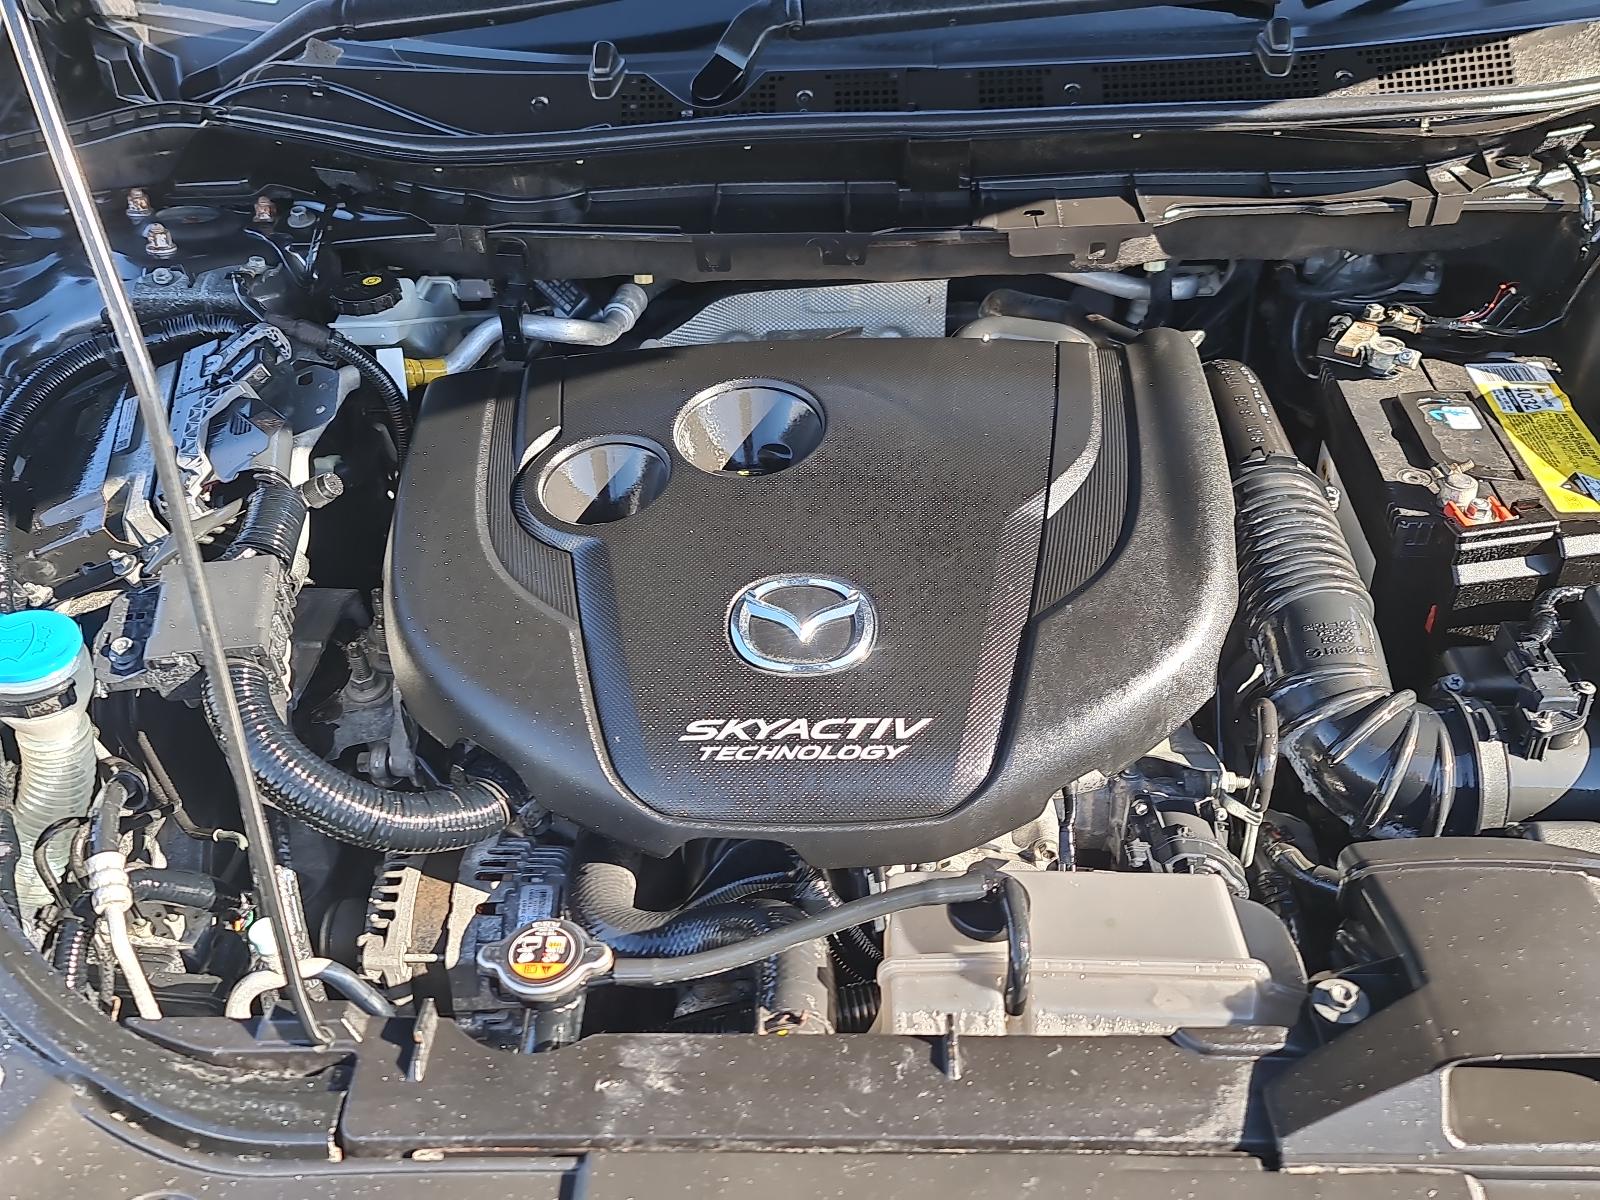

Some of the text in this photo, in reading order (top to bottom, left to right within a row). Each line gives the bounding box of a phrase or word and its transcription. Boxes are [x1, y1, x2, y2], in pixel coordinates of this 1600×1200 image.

[1515, 387, 1542, 411] 4032
[677, 717, 934, 742] SKYACTIV
[699, 744, 911, 761] TECHNOLOGY
